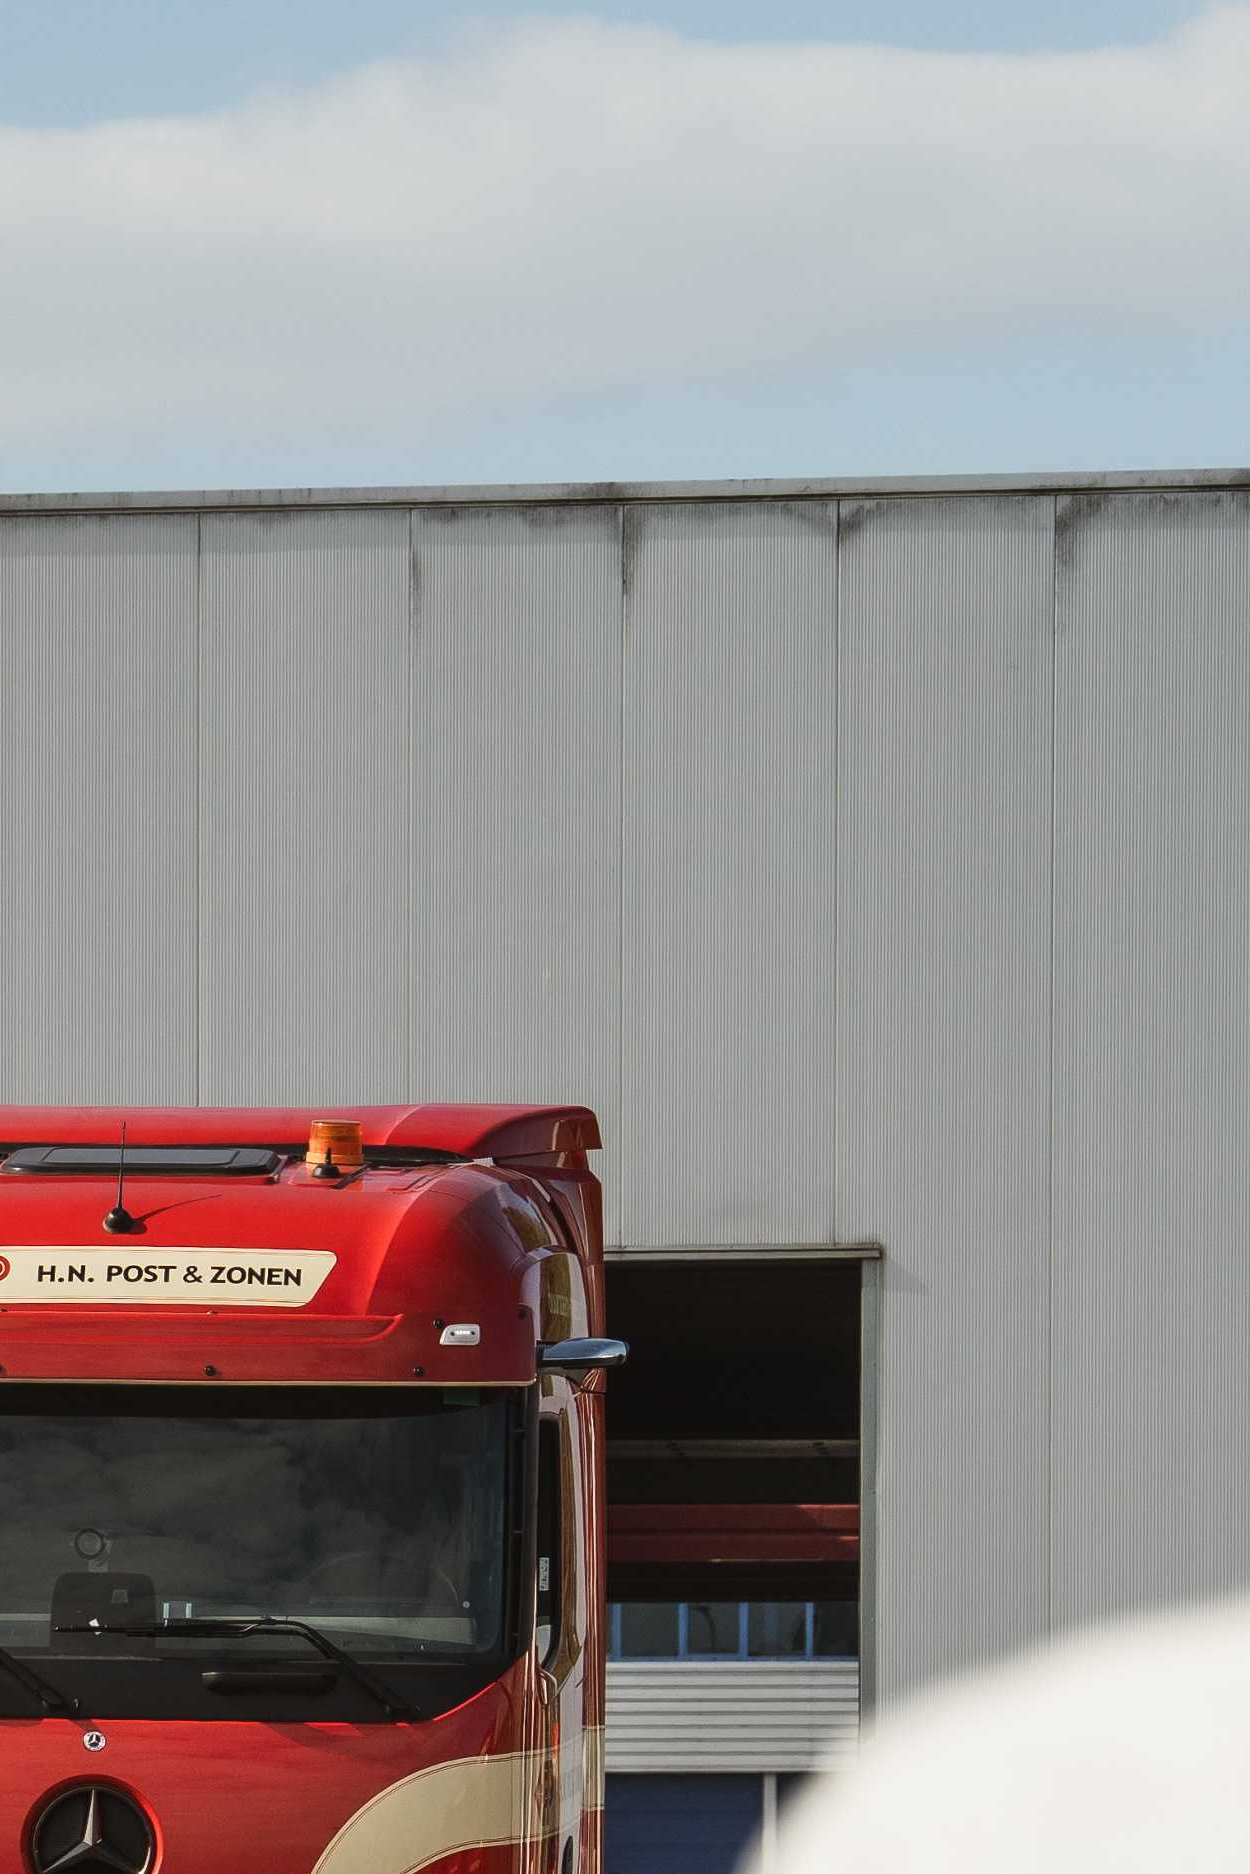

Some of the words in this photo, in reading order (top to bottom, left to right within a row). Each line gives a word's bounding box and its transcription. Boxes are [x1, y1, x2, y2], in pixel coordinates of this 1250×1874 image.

[37, 1264, 94, 1283] H.N.
[106, 1264, 177, 1284] POST
[182, 1266, 203, 1284] &
[210, 1266, 302, 1286] ZONEN
